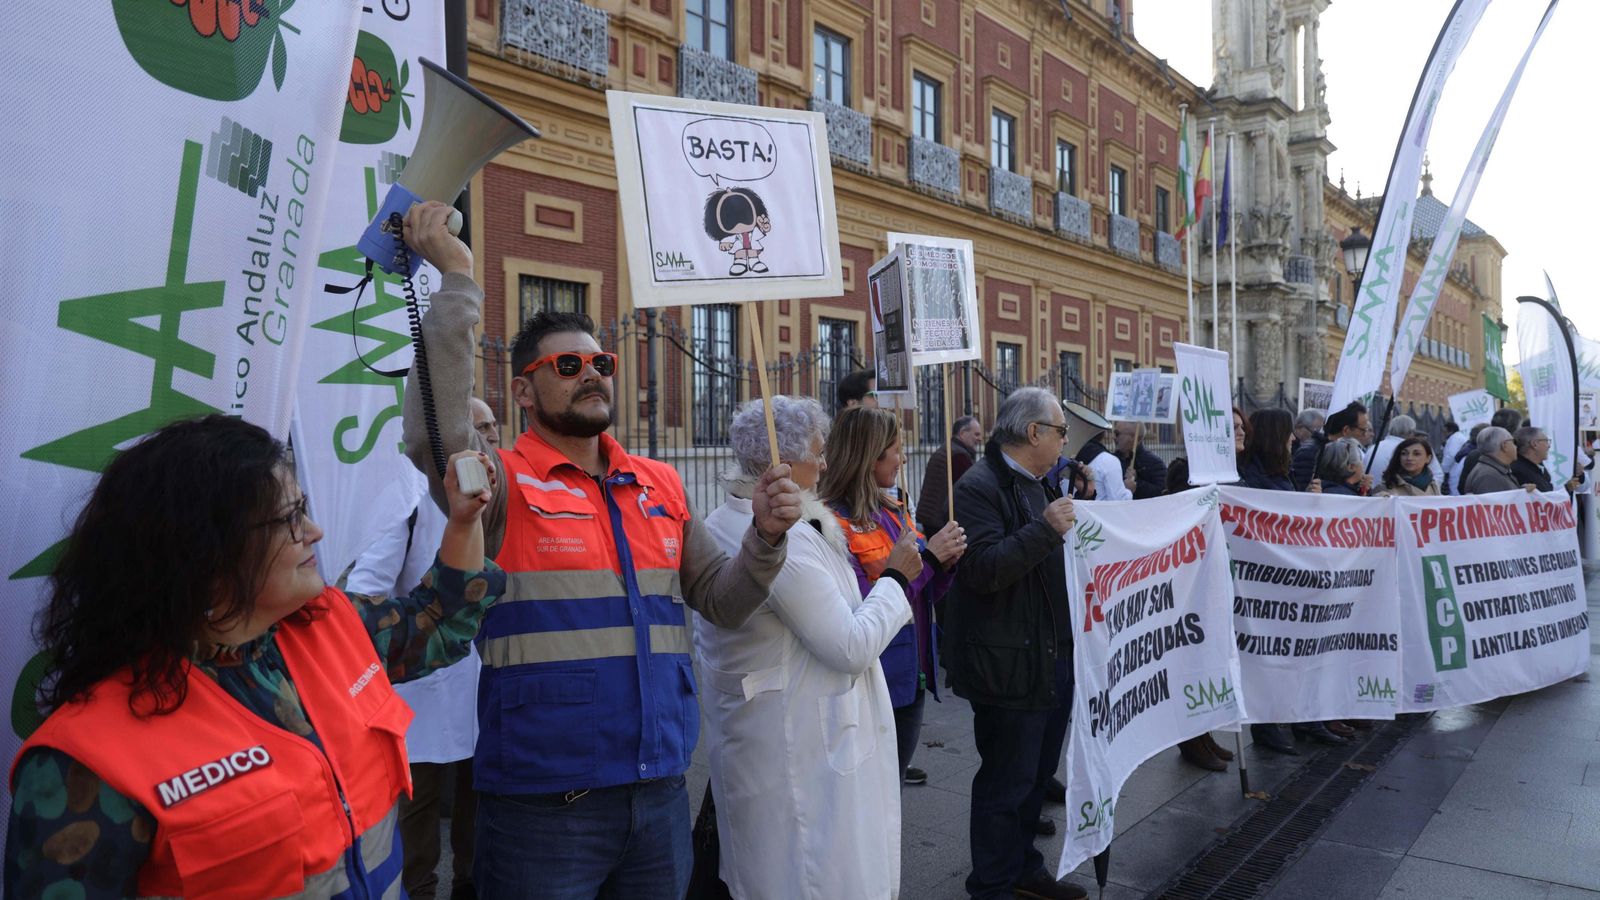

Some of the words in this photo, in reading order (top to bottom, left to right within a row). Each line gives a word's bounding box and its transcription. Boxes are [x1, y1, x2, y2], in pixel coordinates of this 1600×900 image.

[687, 135, 773, 163] BASTA!
[261, 133, 316, 346] Granada
[235, 191, 280, 346] Andaluz
[655, 250, 693, 269] SMA
[1410, 503, 1527, 548] ¡PRIMARIA
[1454, 557, 1539, 586] ETRIBUCIONES
[1126, 588, 1149, 629] HAY
[1147, 578, 1175, 616] SON
[1300, 602, 1355, 623] ATRACTIVOS
[1463, 594, 1531, 622] ONTRATOS
[1530, 583, 1577, 610] ATRACTIVOS
[1293, 637, 1319, 657] BIEN
[1317, 632, 1398, 656] DIMENSIONADAS
[1472, 628, 1538, 660] LANTILLAS
[1536, 622, 1559, 646] BIEN
[1184, 677, 1234, 710] SMA
[1358, 675, 1397, 699] SMA
[158, 745, 270, 806] MEDICO
